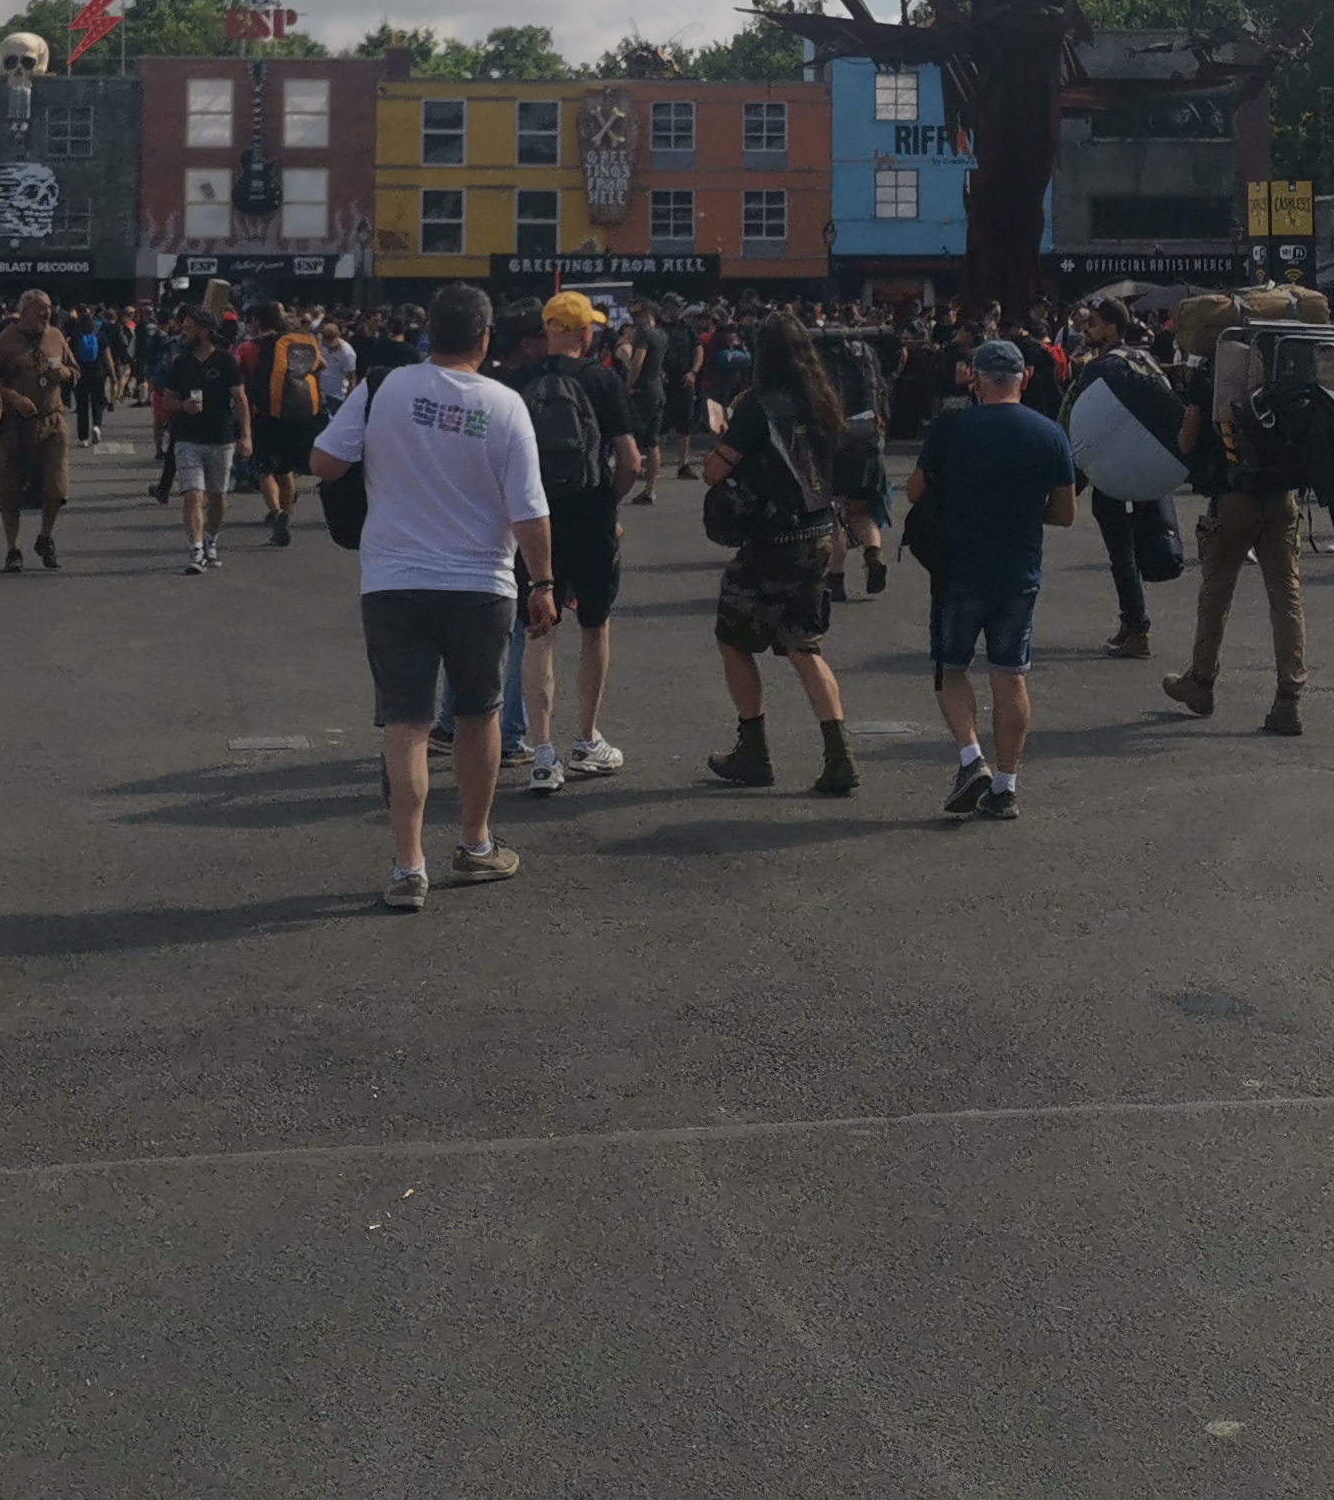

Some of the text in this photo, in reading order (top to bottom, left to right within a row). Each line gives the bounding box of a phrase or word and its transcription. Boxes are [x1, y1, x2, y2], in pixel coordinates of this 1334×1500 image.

[36, 261, 90, 273] RECORDS
[509, 257, 706, 273] GREETINGS FROM HELL
[1193, 258, 1233, 272] MERCH
